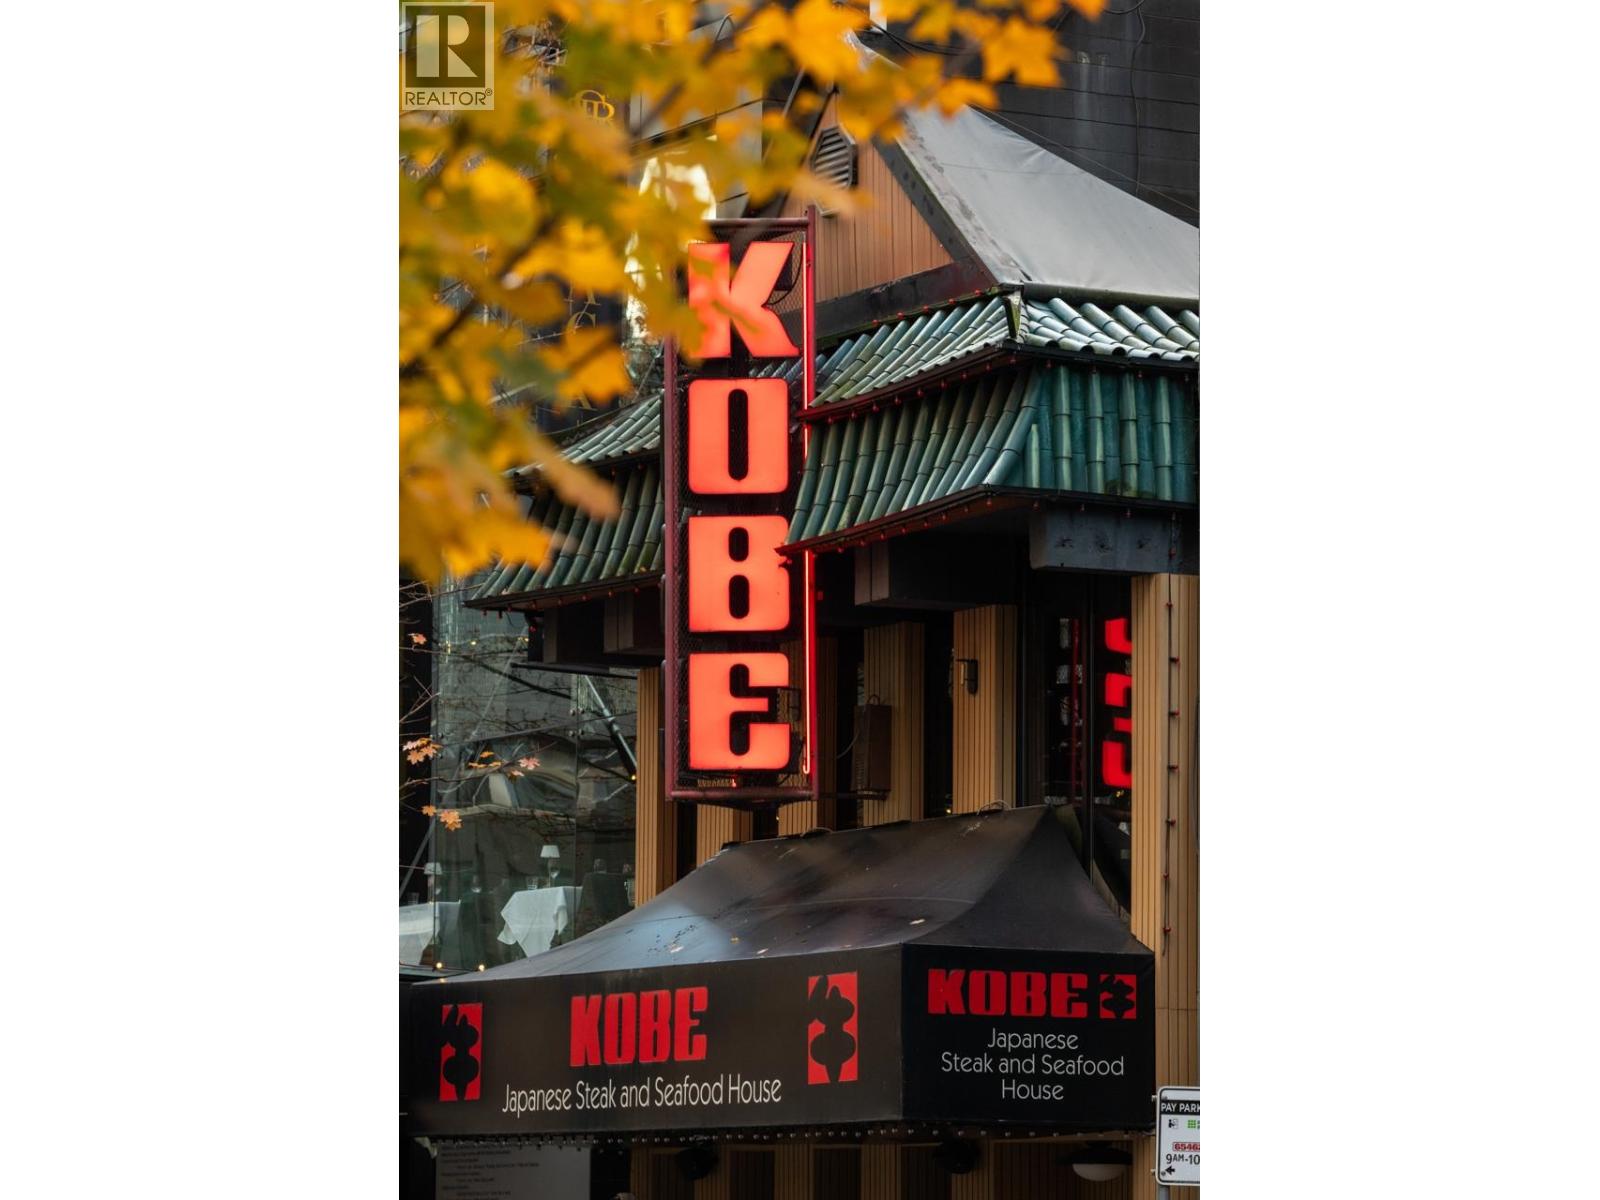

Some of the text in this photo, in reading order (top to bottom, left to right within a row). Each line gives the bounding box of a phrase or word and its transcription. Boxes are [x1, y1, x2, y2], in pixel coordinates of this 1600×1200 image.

[688, 241, 799, 770] KOBE
[928, 969, 1088, 1018] KOBE
[570, 986, 708, 1067] KOBE
[986, 1028, 1079, 1052] Japanese
[941, 1052, 1124, 1076] Steak and Seafood
[502, 1074, 782, 1118] Japanese Steak and Seafood House
[1002, 1079, 1064, 1100] House
[1161, 1103, 1177, 1112] PAY
